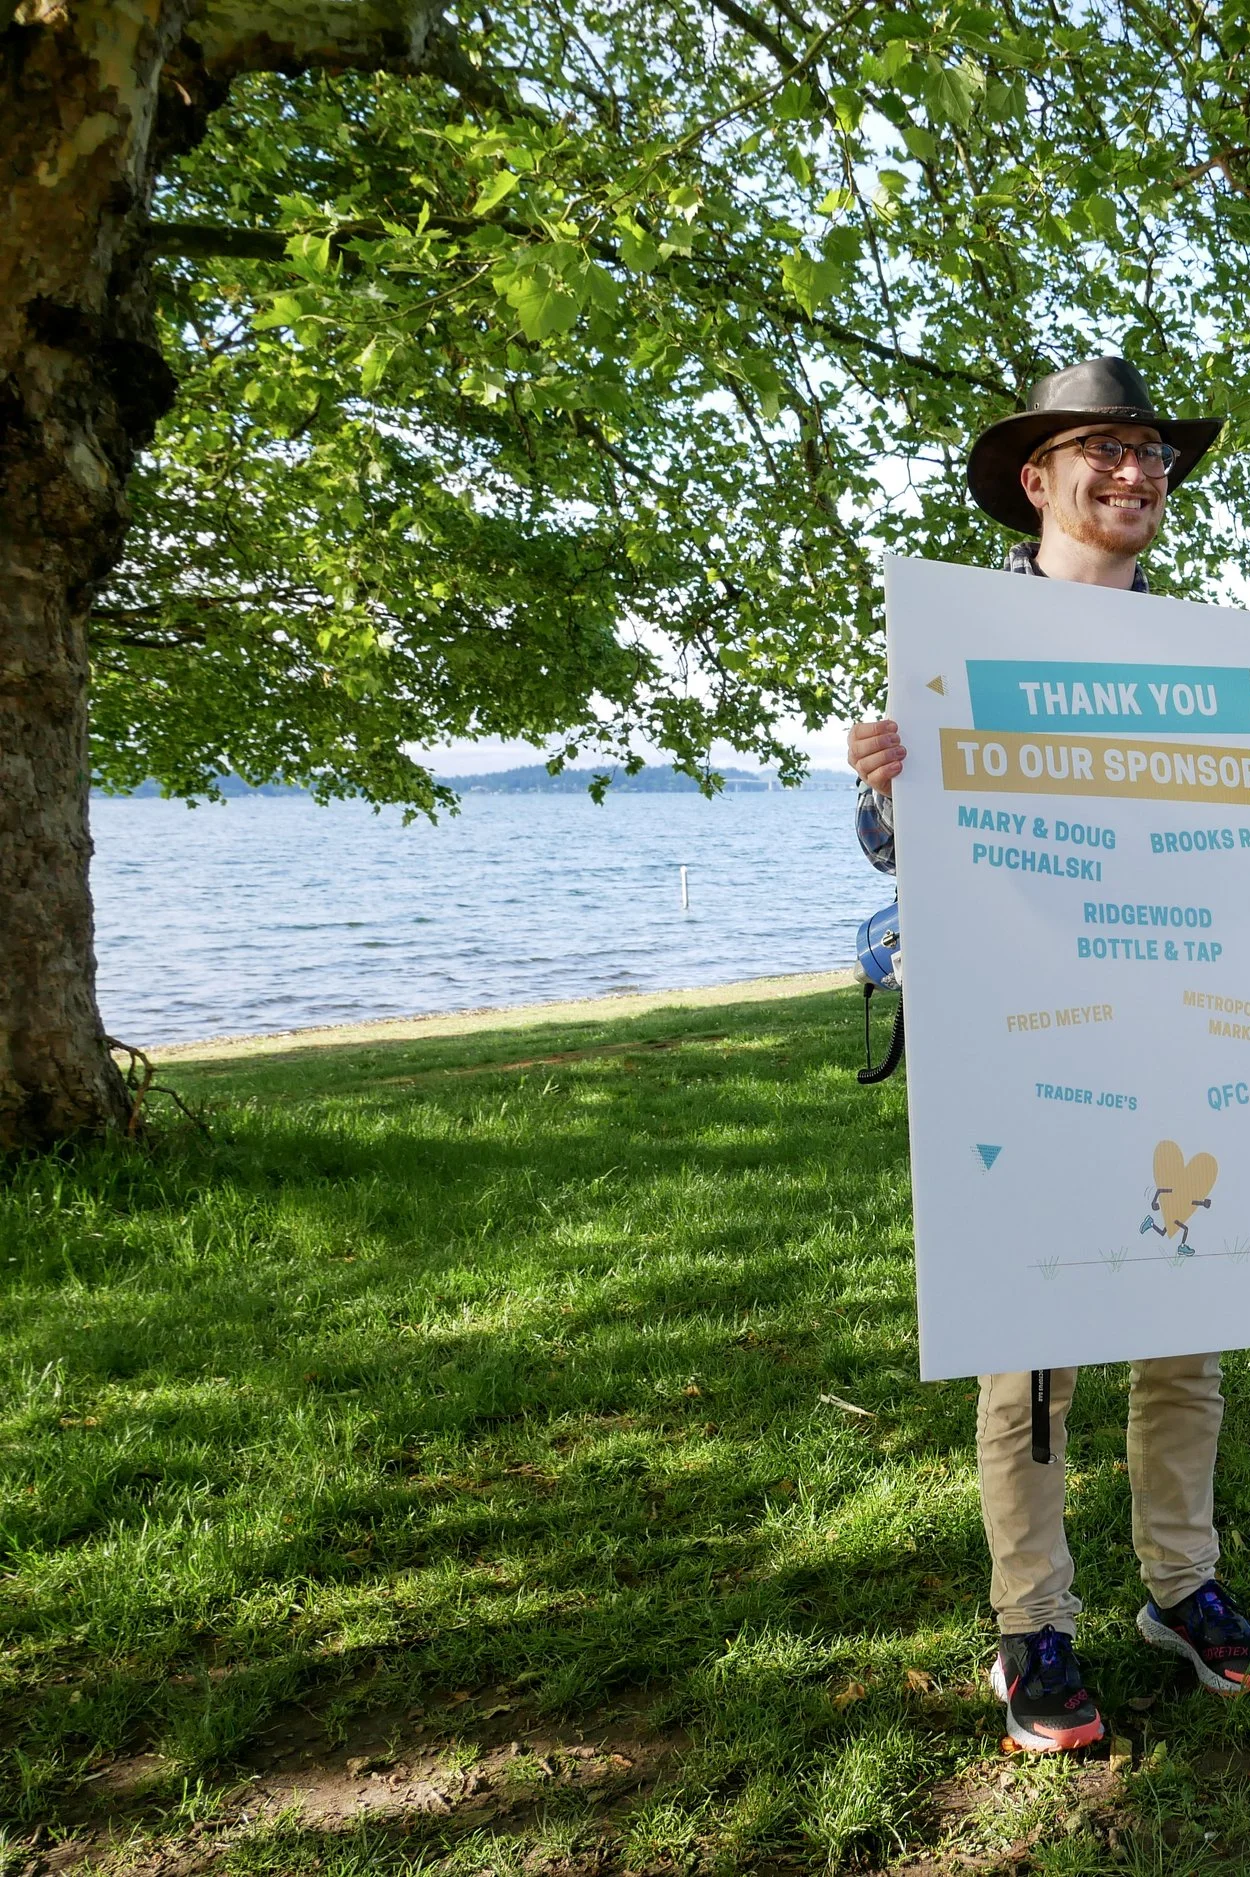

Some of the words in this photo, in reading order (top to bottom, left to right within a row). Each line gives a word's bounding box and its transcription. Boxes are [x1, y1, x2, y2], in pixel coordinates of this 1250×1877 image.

[1018, 681, 1142, 716] THANK
[1148, 683, 1219, 717] YOU
[957, 741, 1008, 776] TO
[1019, 745, 1095, 781] OUR
[958, 805, 1027, 834] MARY
[1032, 817, 1048, 839] &
[1055, 820, 1116, 850] DOUG
[1150, 828, 1234, 853] BROOKS
[972, 843, 1102, 882] PUCHALSKI
[1083, 902, 1213, 928] RIDGEWOOD
[1077, 937, 1158, 960] BOTTLE
[1164, 940, 1179, 961] &
[1184, 941, 1223, 962] TAP
[1006, 1011, 1051, 1032] FRED
[1055, 1004, 1114, 1027] MEYER
[1035, 1083, 1093, 1105] TRADER
[1096, 1092, 1137, 1111] JOE'S
[1207, 1082, 1250, 1111] QFC
